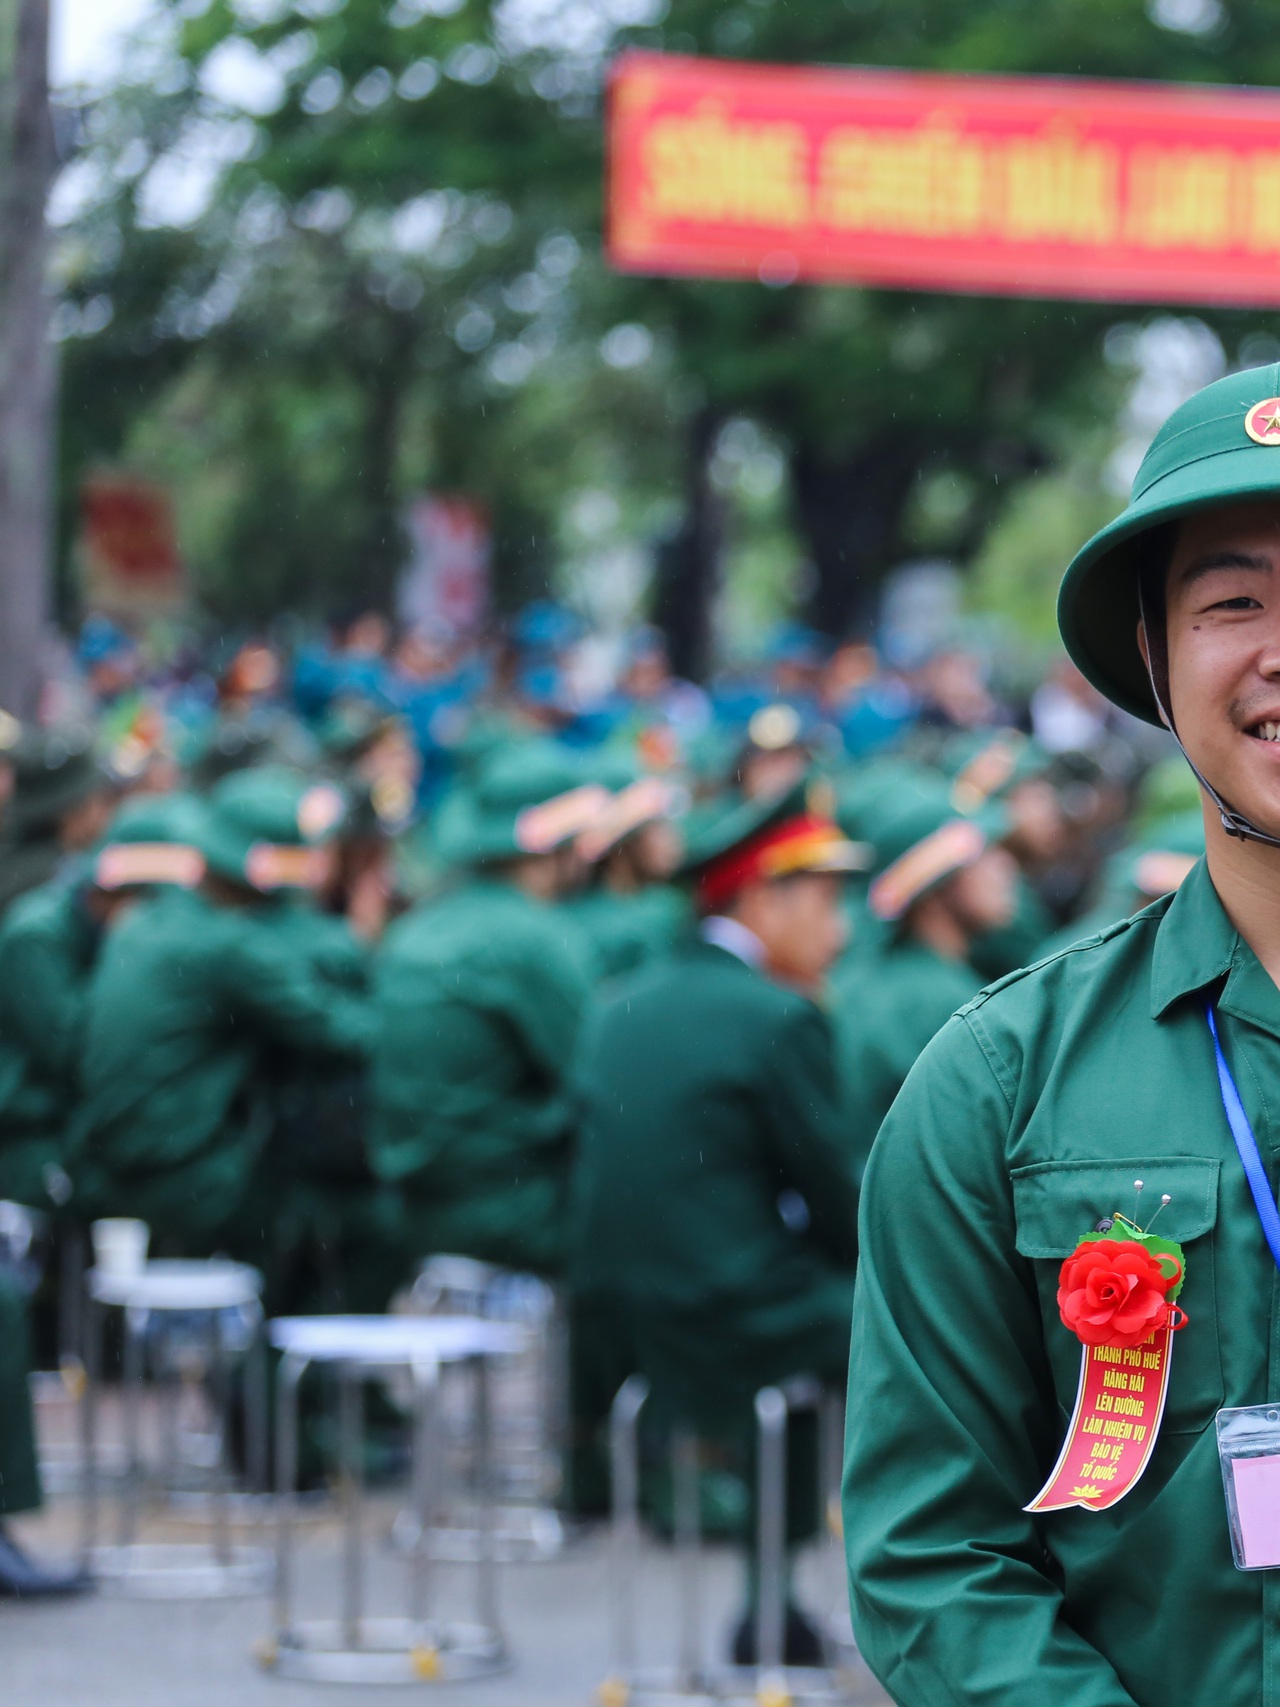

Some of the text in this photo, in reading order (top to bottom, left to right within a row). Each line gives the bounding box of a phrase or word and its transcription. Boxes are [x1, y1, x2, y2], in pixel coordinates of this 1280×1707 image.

[1123, 1345, 1143, 1367] PHỐ
[1143, 1349, 1163, 1371] HUẾ
[1103, 1368, 1145, 1393] HĂNG HÁI
[1095, 1391, 1145, 1417] LÊN ĐƯỜNG
[1082, 1414, 1147, 1445] LÀM NHIỆM VỤ
[1090, 1438, 1111, 1460] BẢO
[1079, 1458, 1118, 1481] TỔ QUỐC
